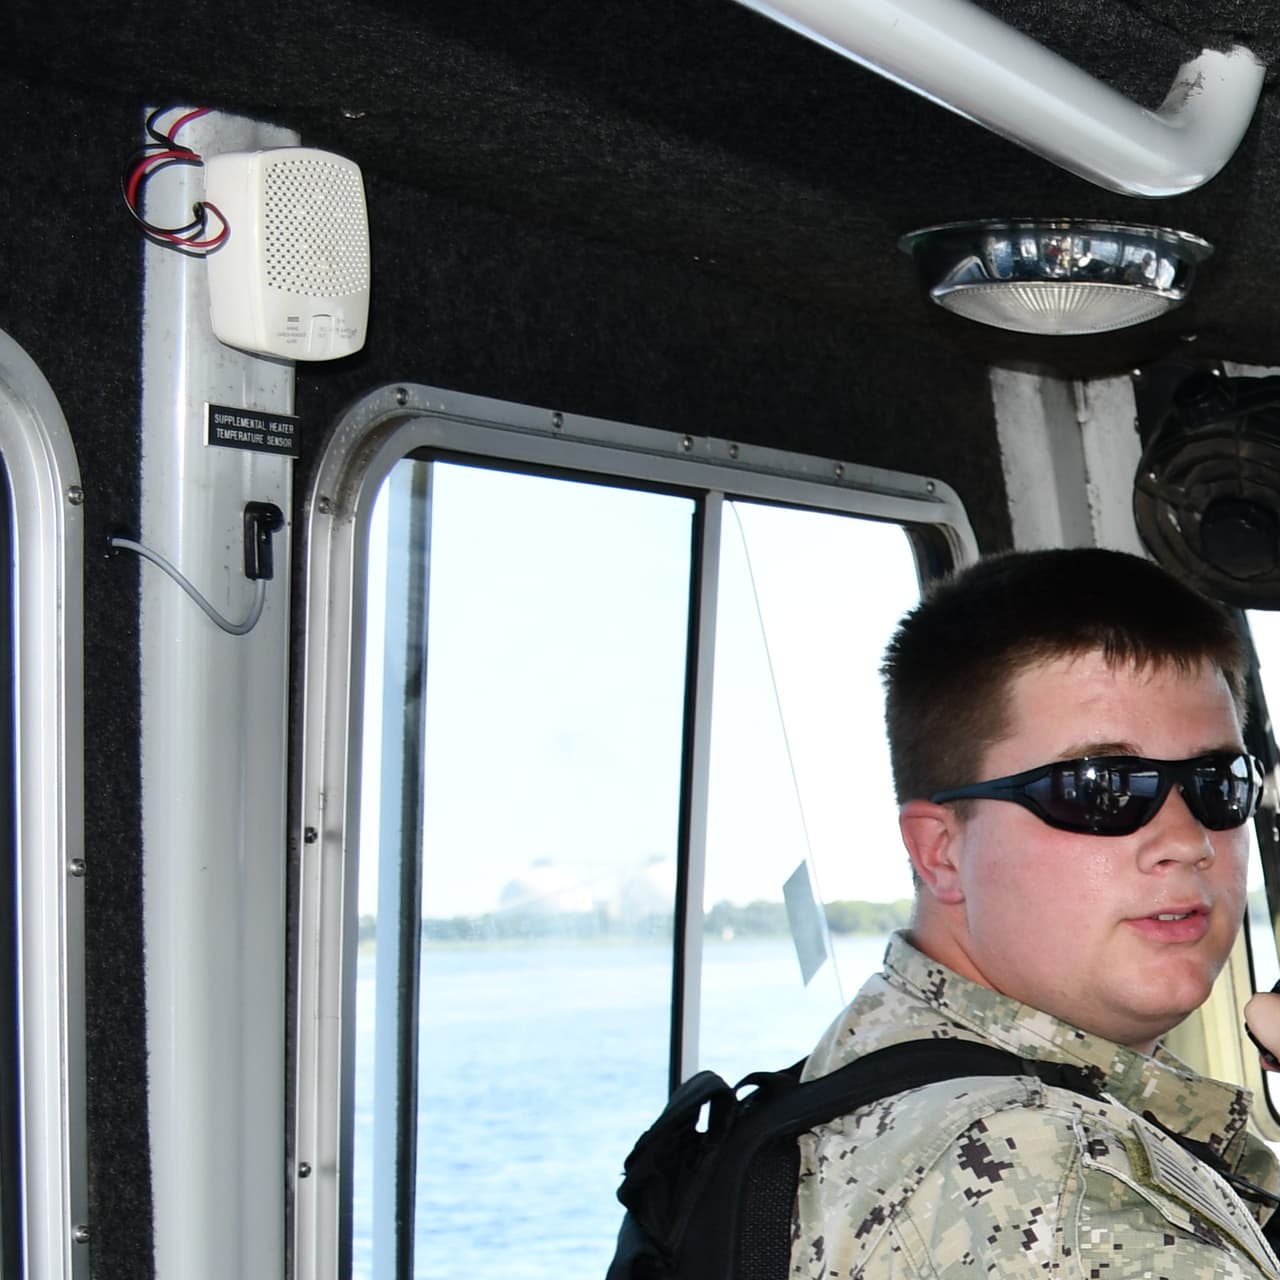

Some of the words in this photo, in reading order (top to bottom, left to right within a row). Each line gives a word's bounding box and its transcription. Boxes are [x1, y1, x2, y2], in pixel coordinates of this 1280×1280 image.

[214, 414, 266, 431] SUPPLEMENTAL
[269, 422, 294, 434] HEATER
[216, 428, 264, 444] TEMPERATURE
[267, 435, 292, 448] SENSOR
